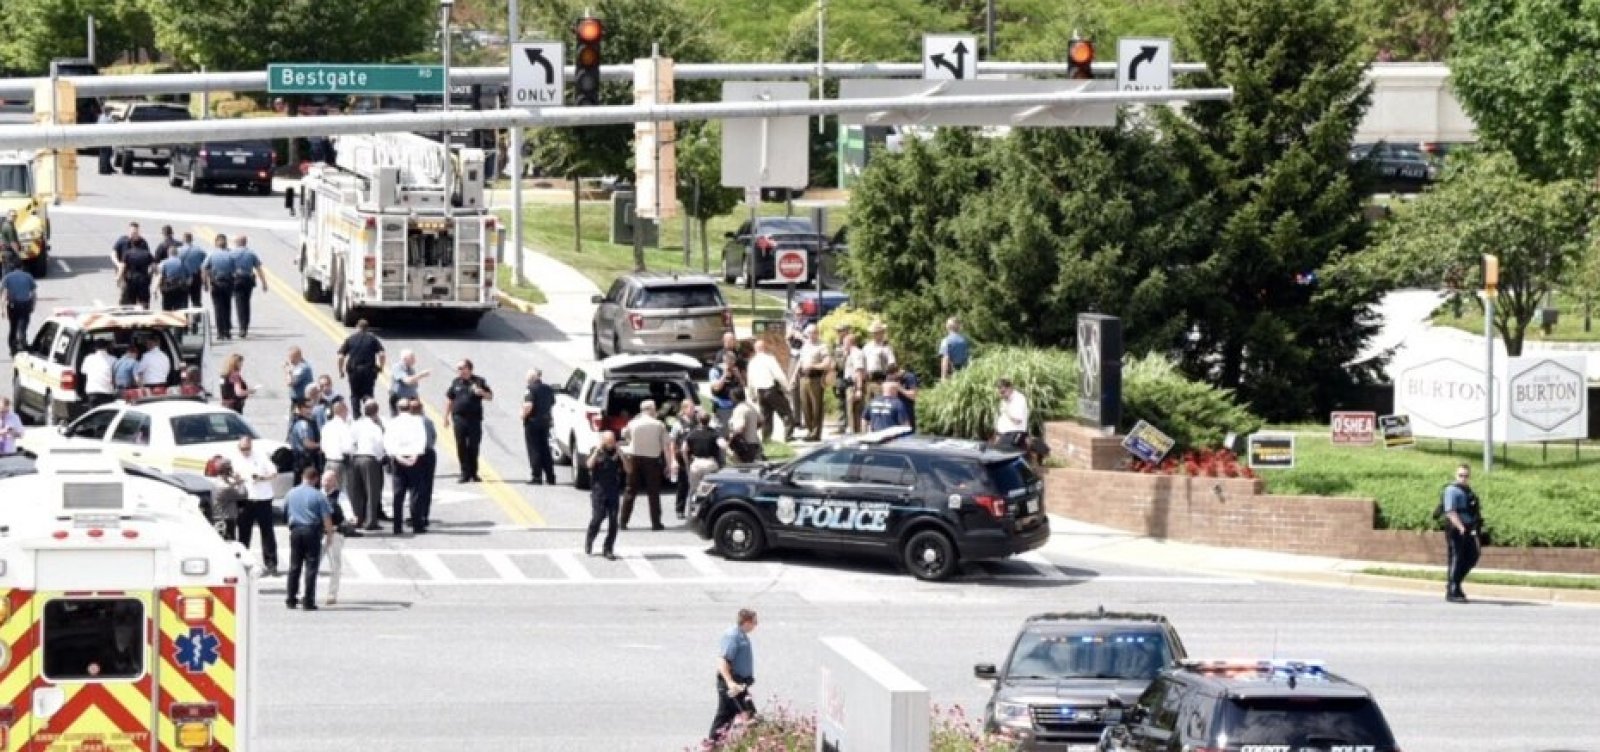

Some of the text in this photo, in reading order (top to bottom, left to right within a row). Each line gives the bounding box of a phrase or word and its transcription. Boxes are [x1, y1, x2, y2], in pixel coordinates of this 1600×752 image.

[281, 67, 433, 91] Bestgate RD
[517, 88, 556, 100] ONLY
[1408, 378, 1488, 401] BURTON
[1516, 382, 1577, 401] BURTON
[795, 505, 889, 532] POLICE
